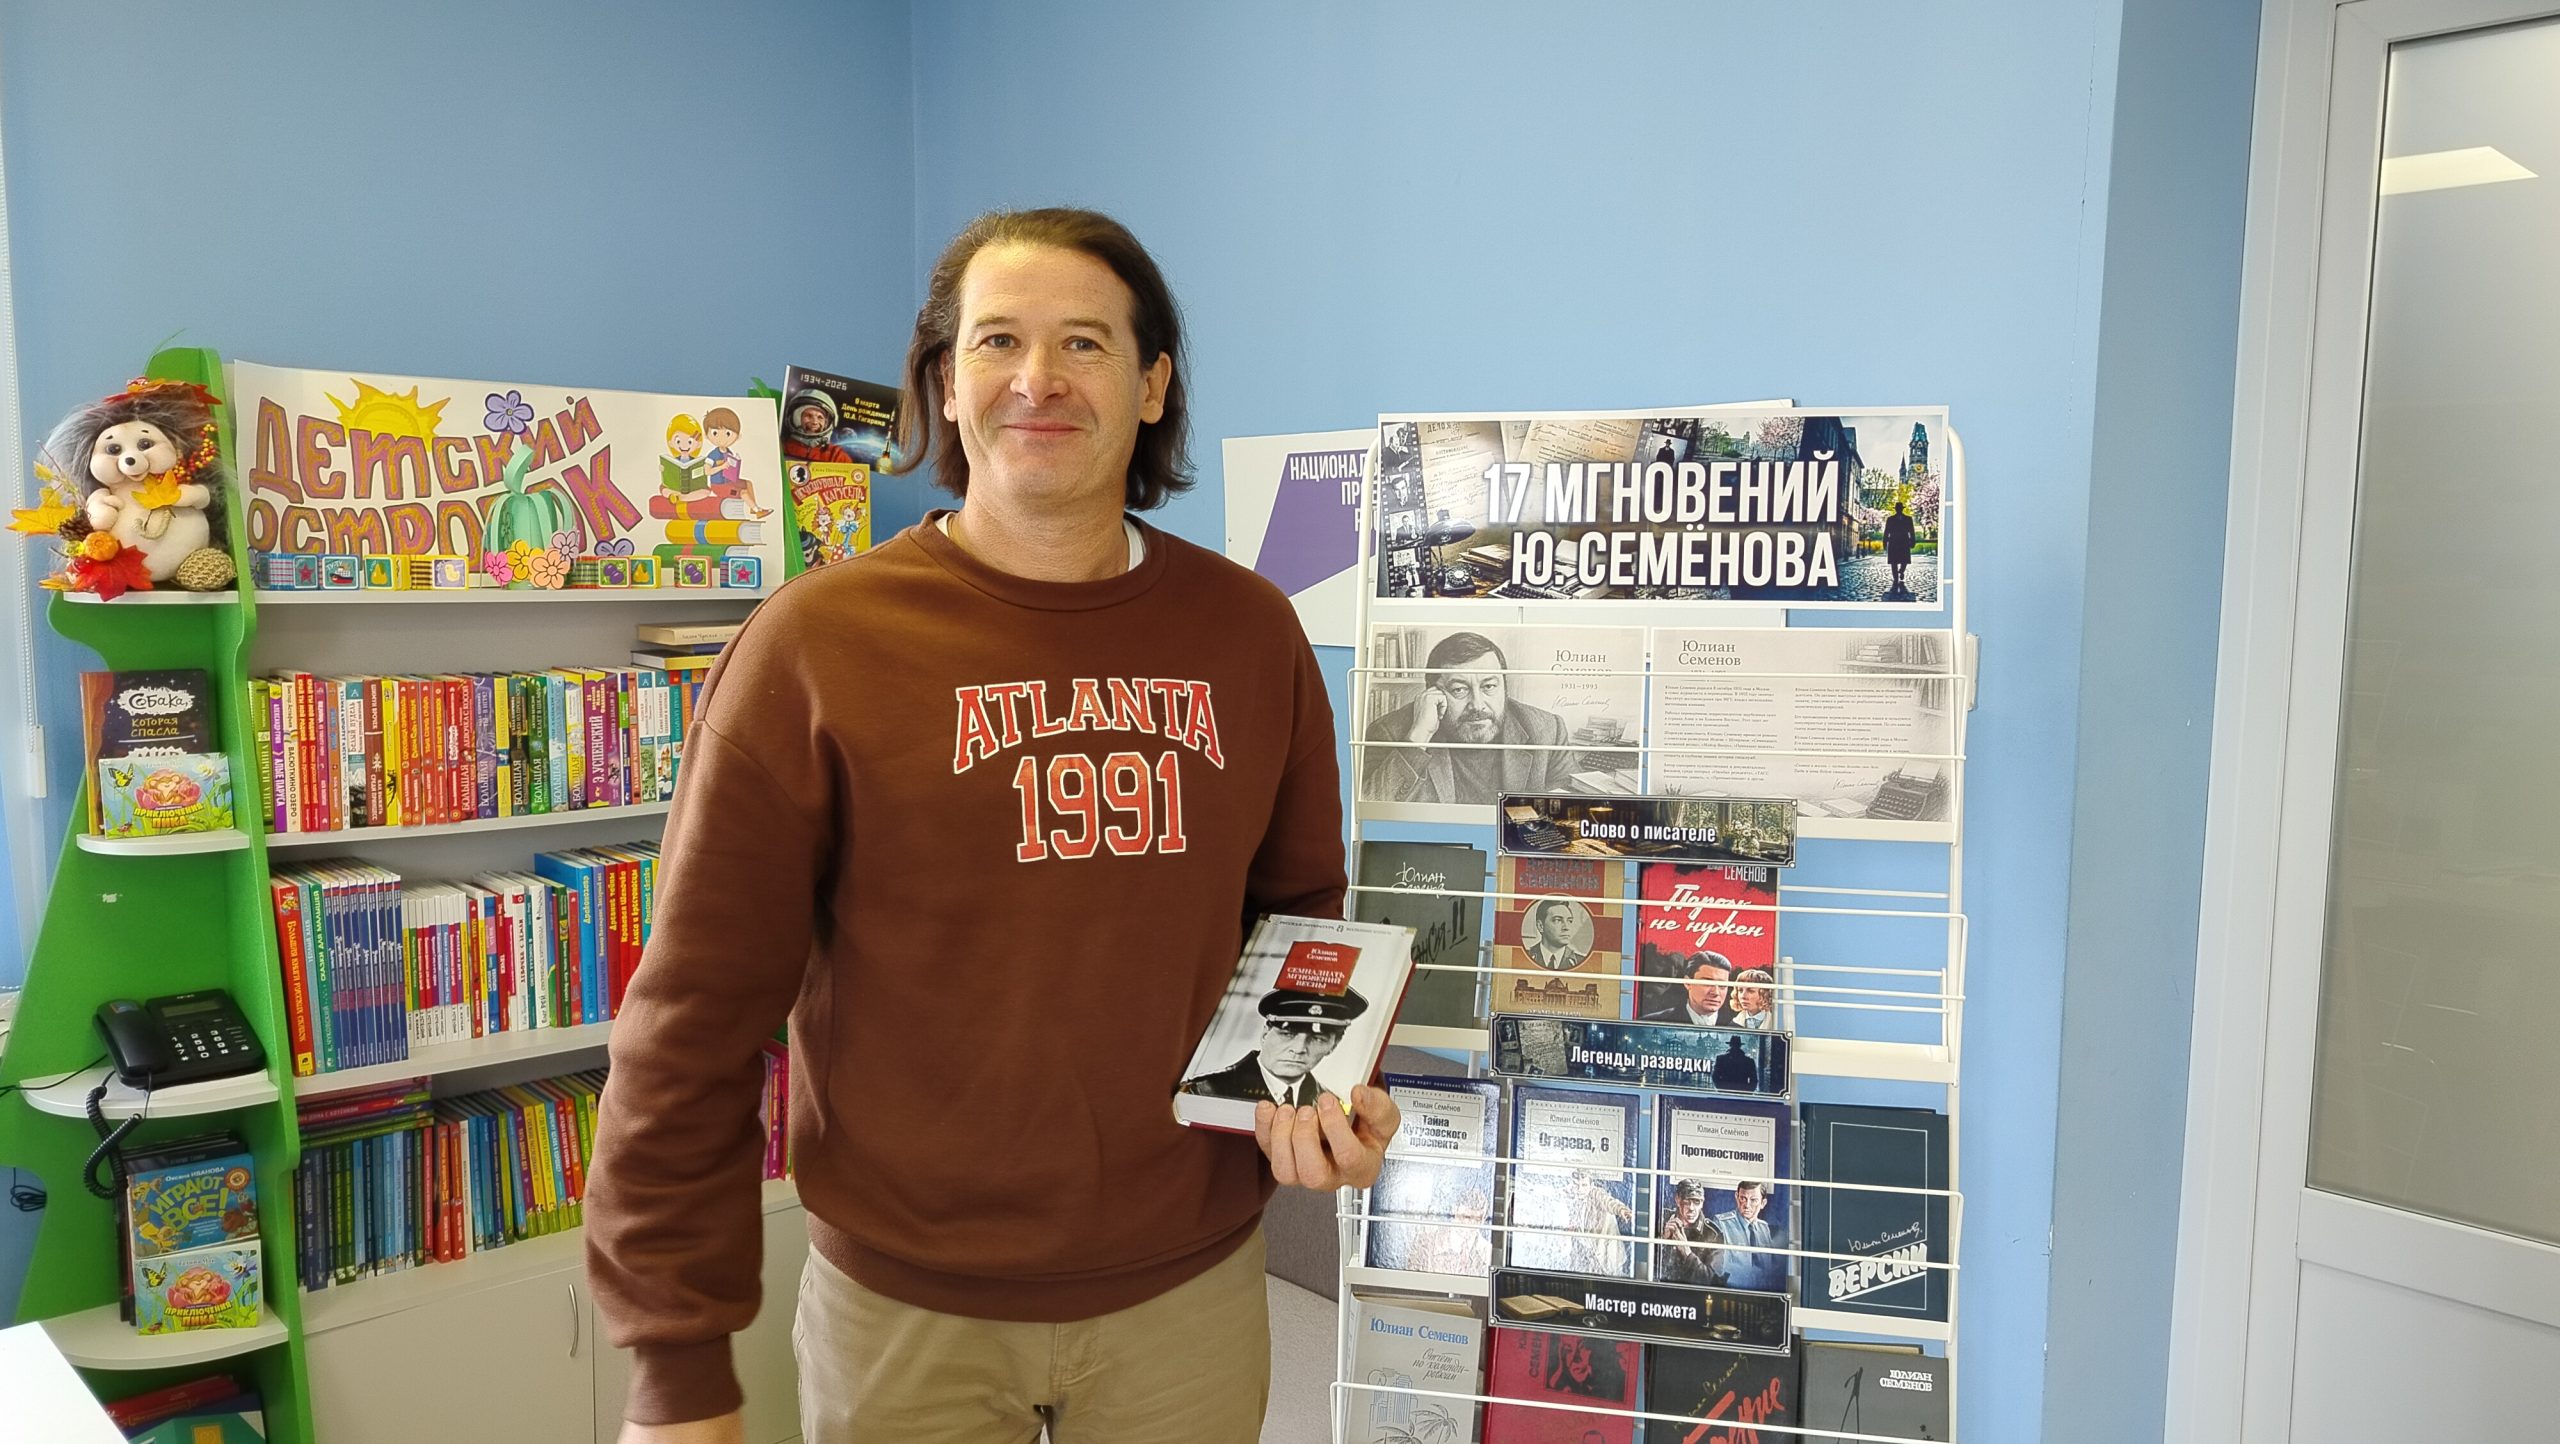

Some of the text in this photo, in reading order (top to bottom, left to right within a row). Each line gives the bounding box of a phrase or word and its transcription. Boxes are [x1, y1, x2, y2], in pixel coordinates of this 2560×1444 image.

[1486, 462, 1533, 523] 17
[1545, 451, 1839, 523] МГНОВЕНИЙ
[1512, 523, 1839, 587] Ю. СЕМЁНОВА
[1556, 650, 1606, 663] Юлиан
[1678, 653, 1741, 665] Семенов
[1683, 640, 1735, 652] Юлиан
[954, 677, 1224, 774] ATLANTA
[589, 716, 604, 783] Э. УСПЕНСКИЙ
[275, 759, 285, 806] АЛЫЕ ПАРУСА
[288, 747, 296, 792] ВАСЮТКИНО
[514, 760, 523, 805] БОЛЬШАЯ
[533, 758, 543, 803] БОЛЬШАЯ
[553, 759, 562, 803] БОЛЬШАЯ
[571, 757, 581, 801] БОЛЬШАЯ
[461, 765, 470, 810] БОЛЬШАЯ
[480, 761, 489, 806] БОЛЬШАЯ
[1013, 751, 1186, 862] 1991
[1581, 820, 1715, 842] Слово о писателе
[314, 890, 323, 931] МАЛЫШЕЙ
[632, 923, 640, 946] Алиса
[1650, 911, 1764, 948] не нужен
[319, 951, 327, 981] СКАЗКИ
[200, 1051, 210, 1059] 0
[1571, 1046, 1711, 1073] Легенды разведки
[1413, 1101, 1433, 1109] Юлиан
[1550, 1114, 1570, 1122] Юлиан
[1403, 1123, 1467, 1140] Кутузовского
[1423, 1115, 1449, 1127] Тайна
[1697, 1125, 1748, 1136] Юлиан Семёнов
[1410, 1136, 1458, 1150] проспекта
[1601, 1137, 1609, 1152] 6
[1681, 1144, 1764, 1162] Противостояние
[150, 1176, 224, 1215] ИГРАЮТ
[1828, 1243, 1927, 1298] ВЕРСИИ
[164, 1302, 232, 1316] ПРИКЛЮЧЕНИЯ
[182, 1314, 216, 1326] ПИКА
[1586, 1294, 1696, 1320] Мастер сюжета
[1370, 1318, 1468, 1344] Юлиан Семенов
[1890, 1370, 1933, 1382] ЮЛИАН
